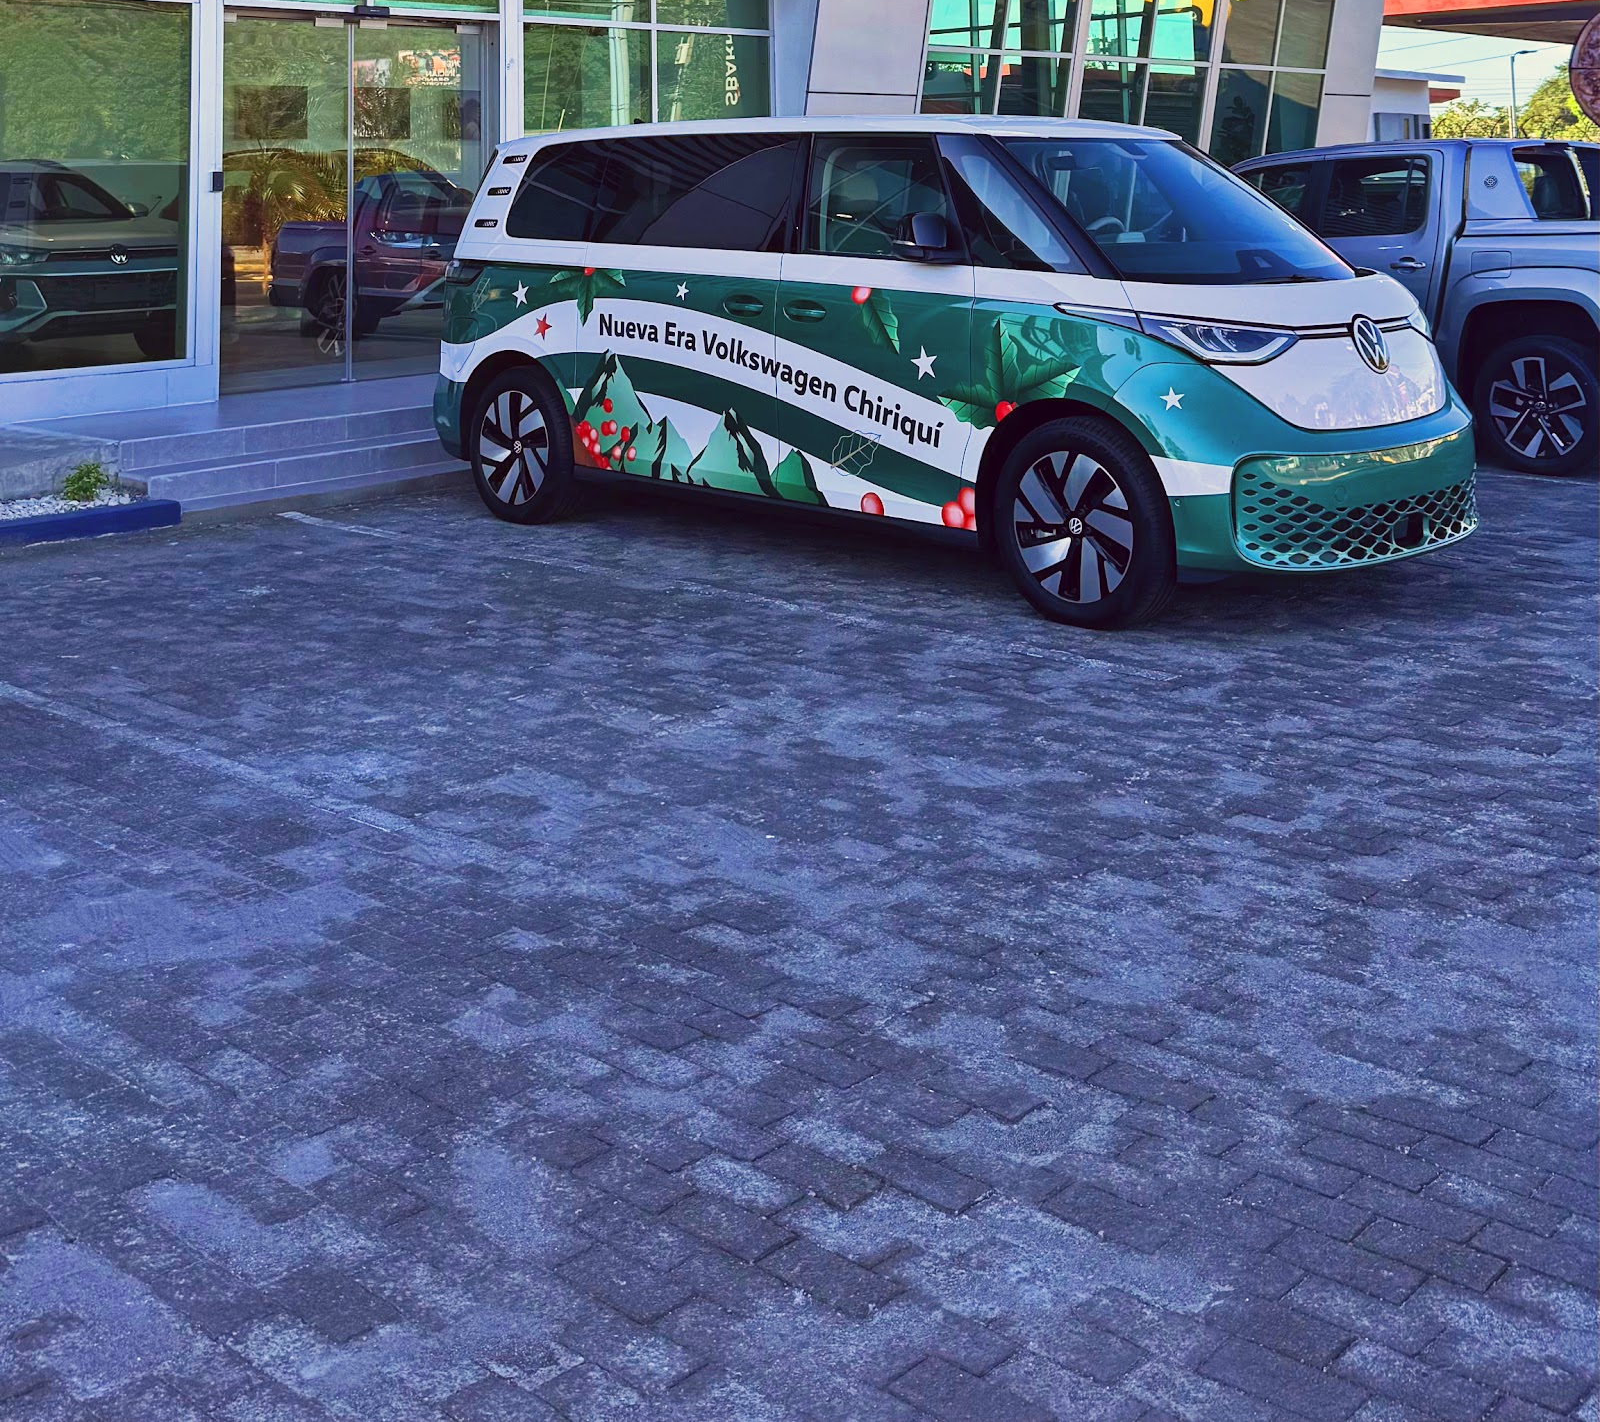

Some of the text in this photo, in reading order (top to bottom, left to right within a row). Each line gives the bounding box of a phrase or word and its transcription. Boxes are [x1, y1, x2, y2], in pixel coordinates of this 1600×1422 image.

[598, 313, 944, 449] Nueva Era Volkswagen Chiriquí
[1354, 318, 1388, 371] VW
